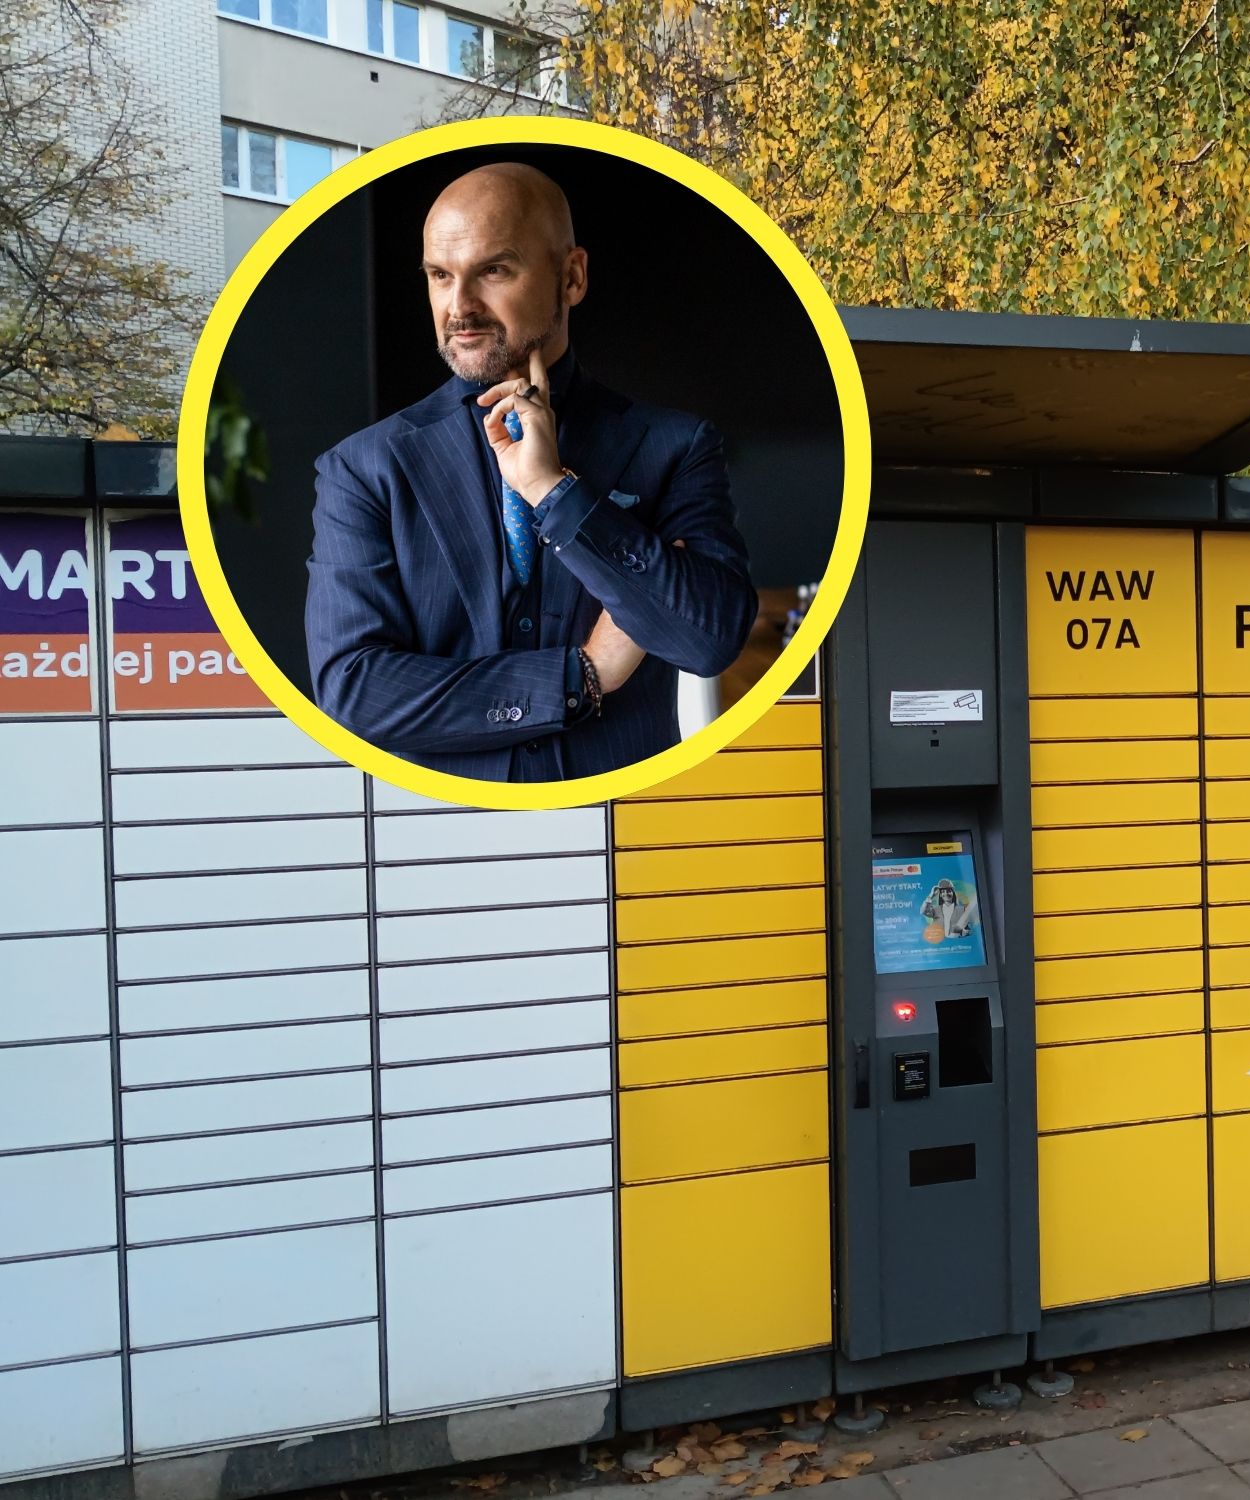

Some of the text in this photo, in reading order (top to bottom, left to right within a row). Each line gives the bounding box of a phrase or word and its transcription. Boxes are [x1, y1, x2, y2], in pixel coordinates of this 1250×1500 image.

[1046, 570, 1154, 601] WAW
[1067, 618, 1140, 650] 07A
[0, 642, 153, 684] ażdej
